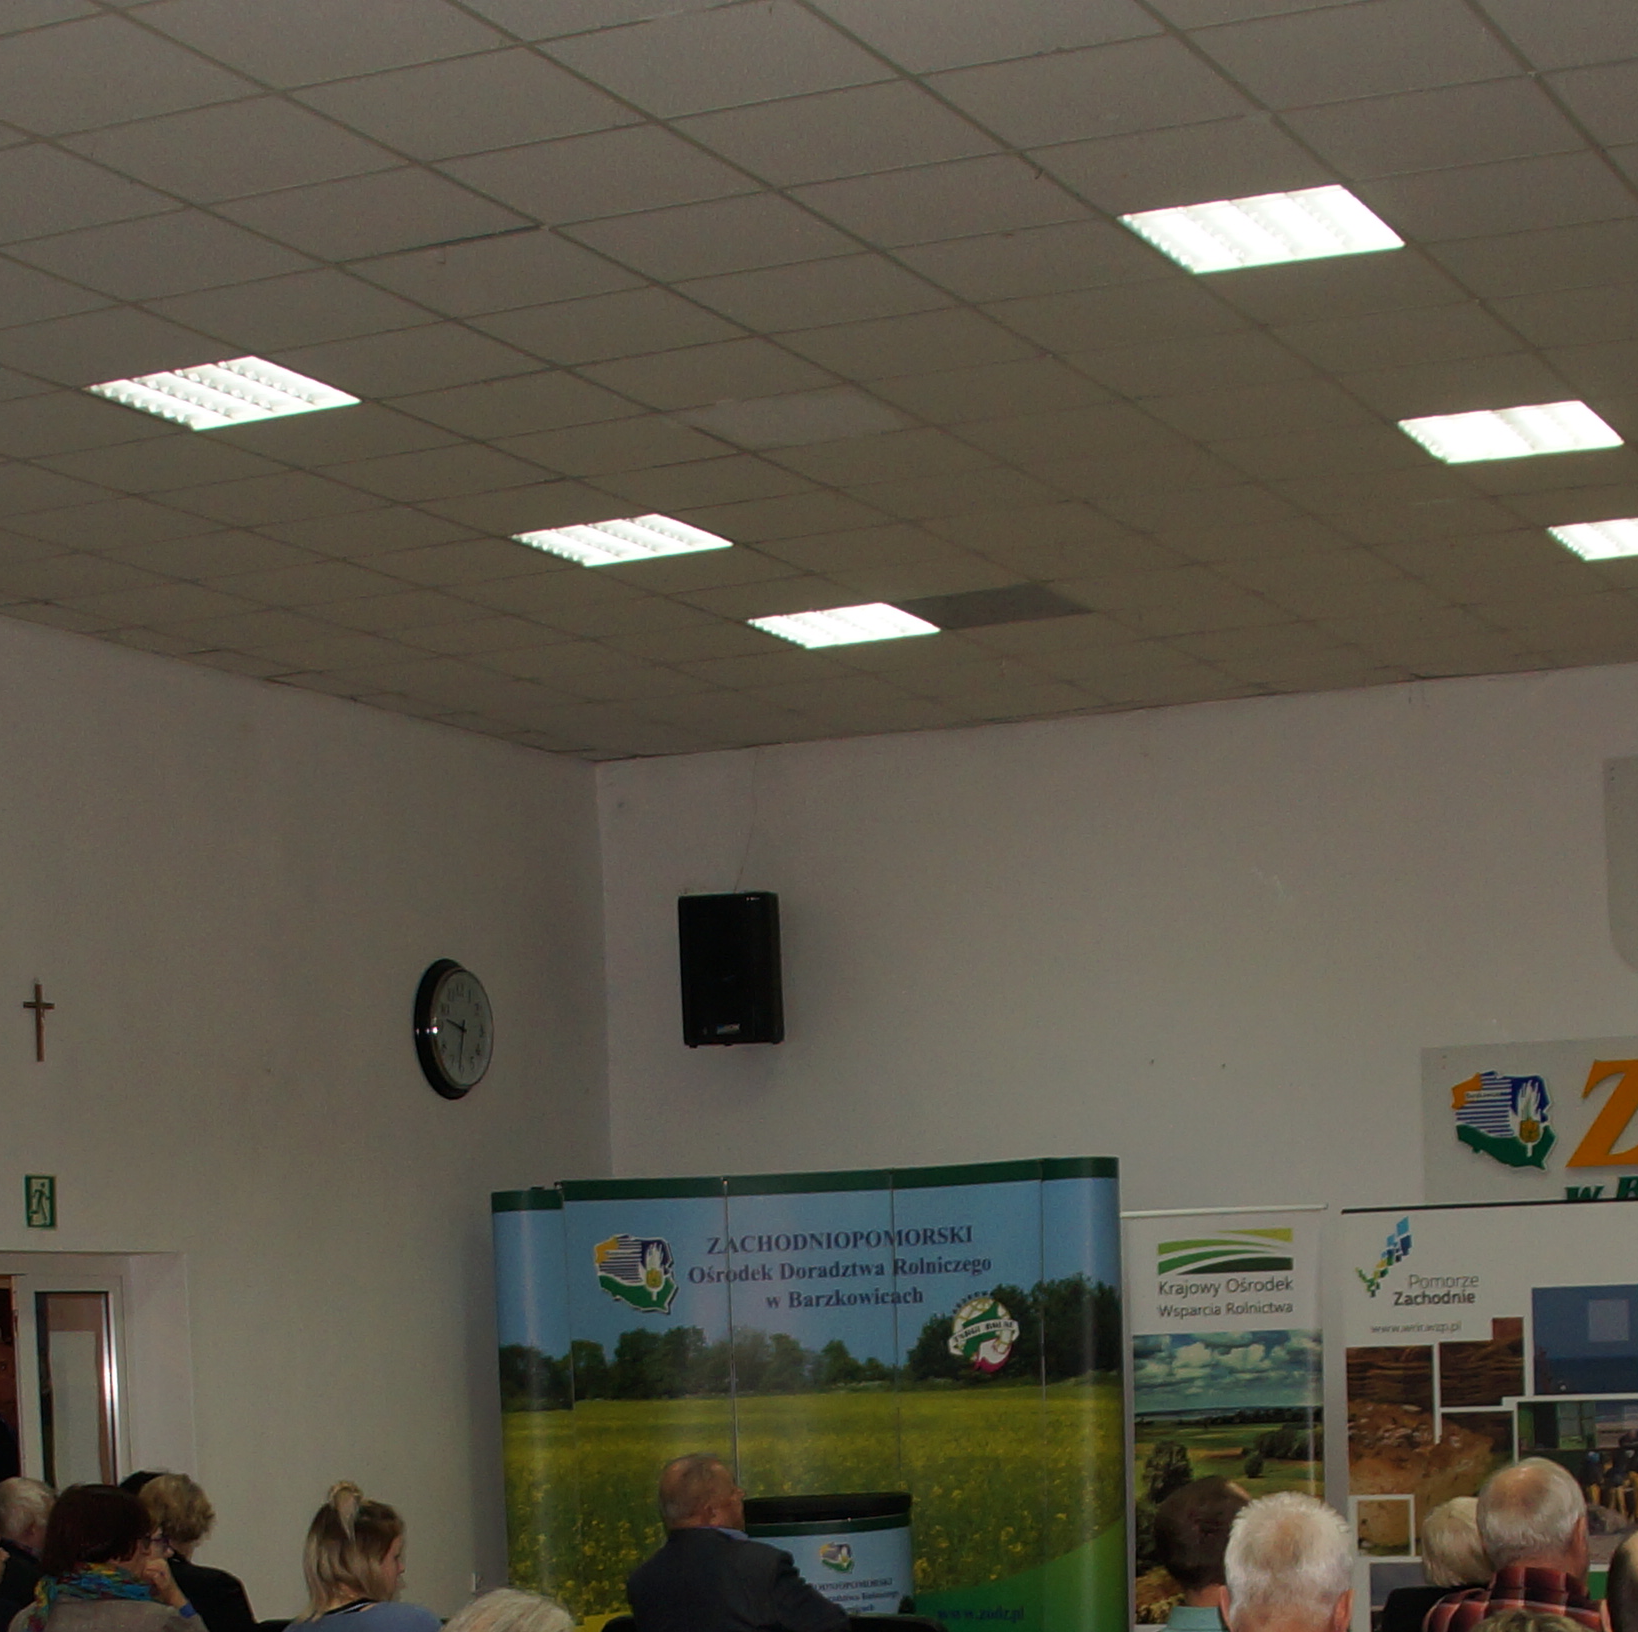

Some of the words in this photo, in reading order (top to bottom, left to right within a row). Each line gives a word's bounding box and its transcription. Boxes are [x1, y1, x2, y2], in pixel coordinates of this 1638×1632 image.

[1564, 1185, 1602, 1200] w
[707, 1225, 974, 1255] ZACHODNIOPOMORSKI
[688, 1261, 773, 1284] Ośrodek
[780, 1258, 885, 1281] Doradztwa
[893, 1255, 992, 1277] Rolniczego
[1158, 1279, 1221, 1299] Krajowy
[1226, 1276, 1293, 1293] Ośrodek
[1409, 1275, 1479, 1289] Pomorze
[766, 1294, 781, 1308] w
[789, 1286, 924, 1309] Barzkowicach
[1393, 1290, 1476, 1306] Zachodnie
[1157, 1303, 1222, 1320] Wsparcia
[1226, 1300, 1293, 1315] Rolnictwa
